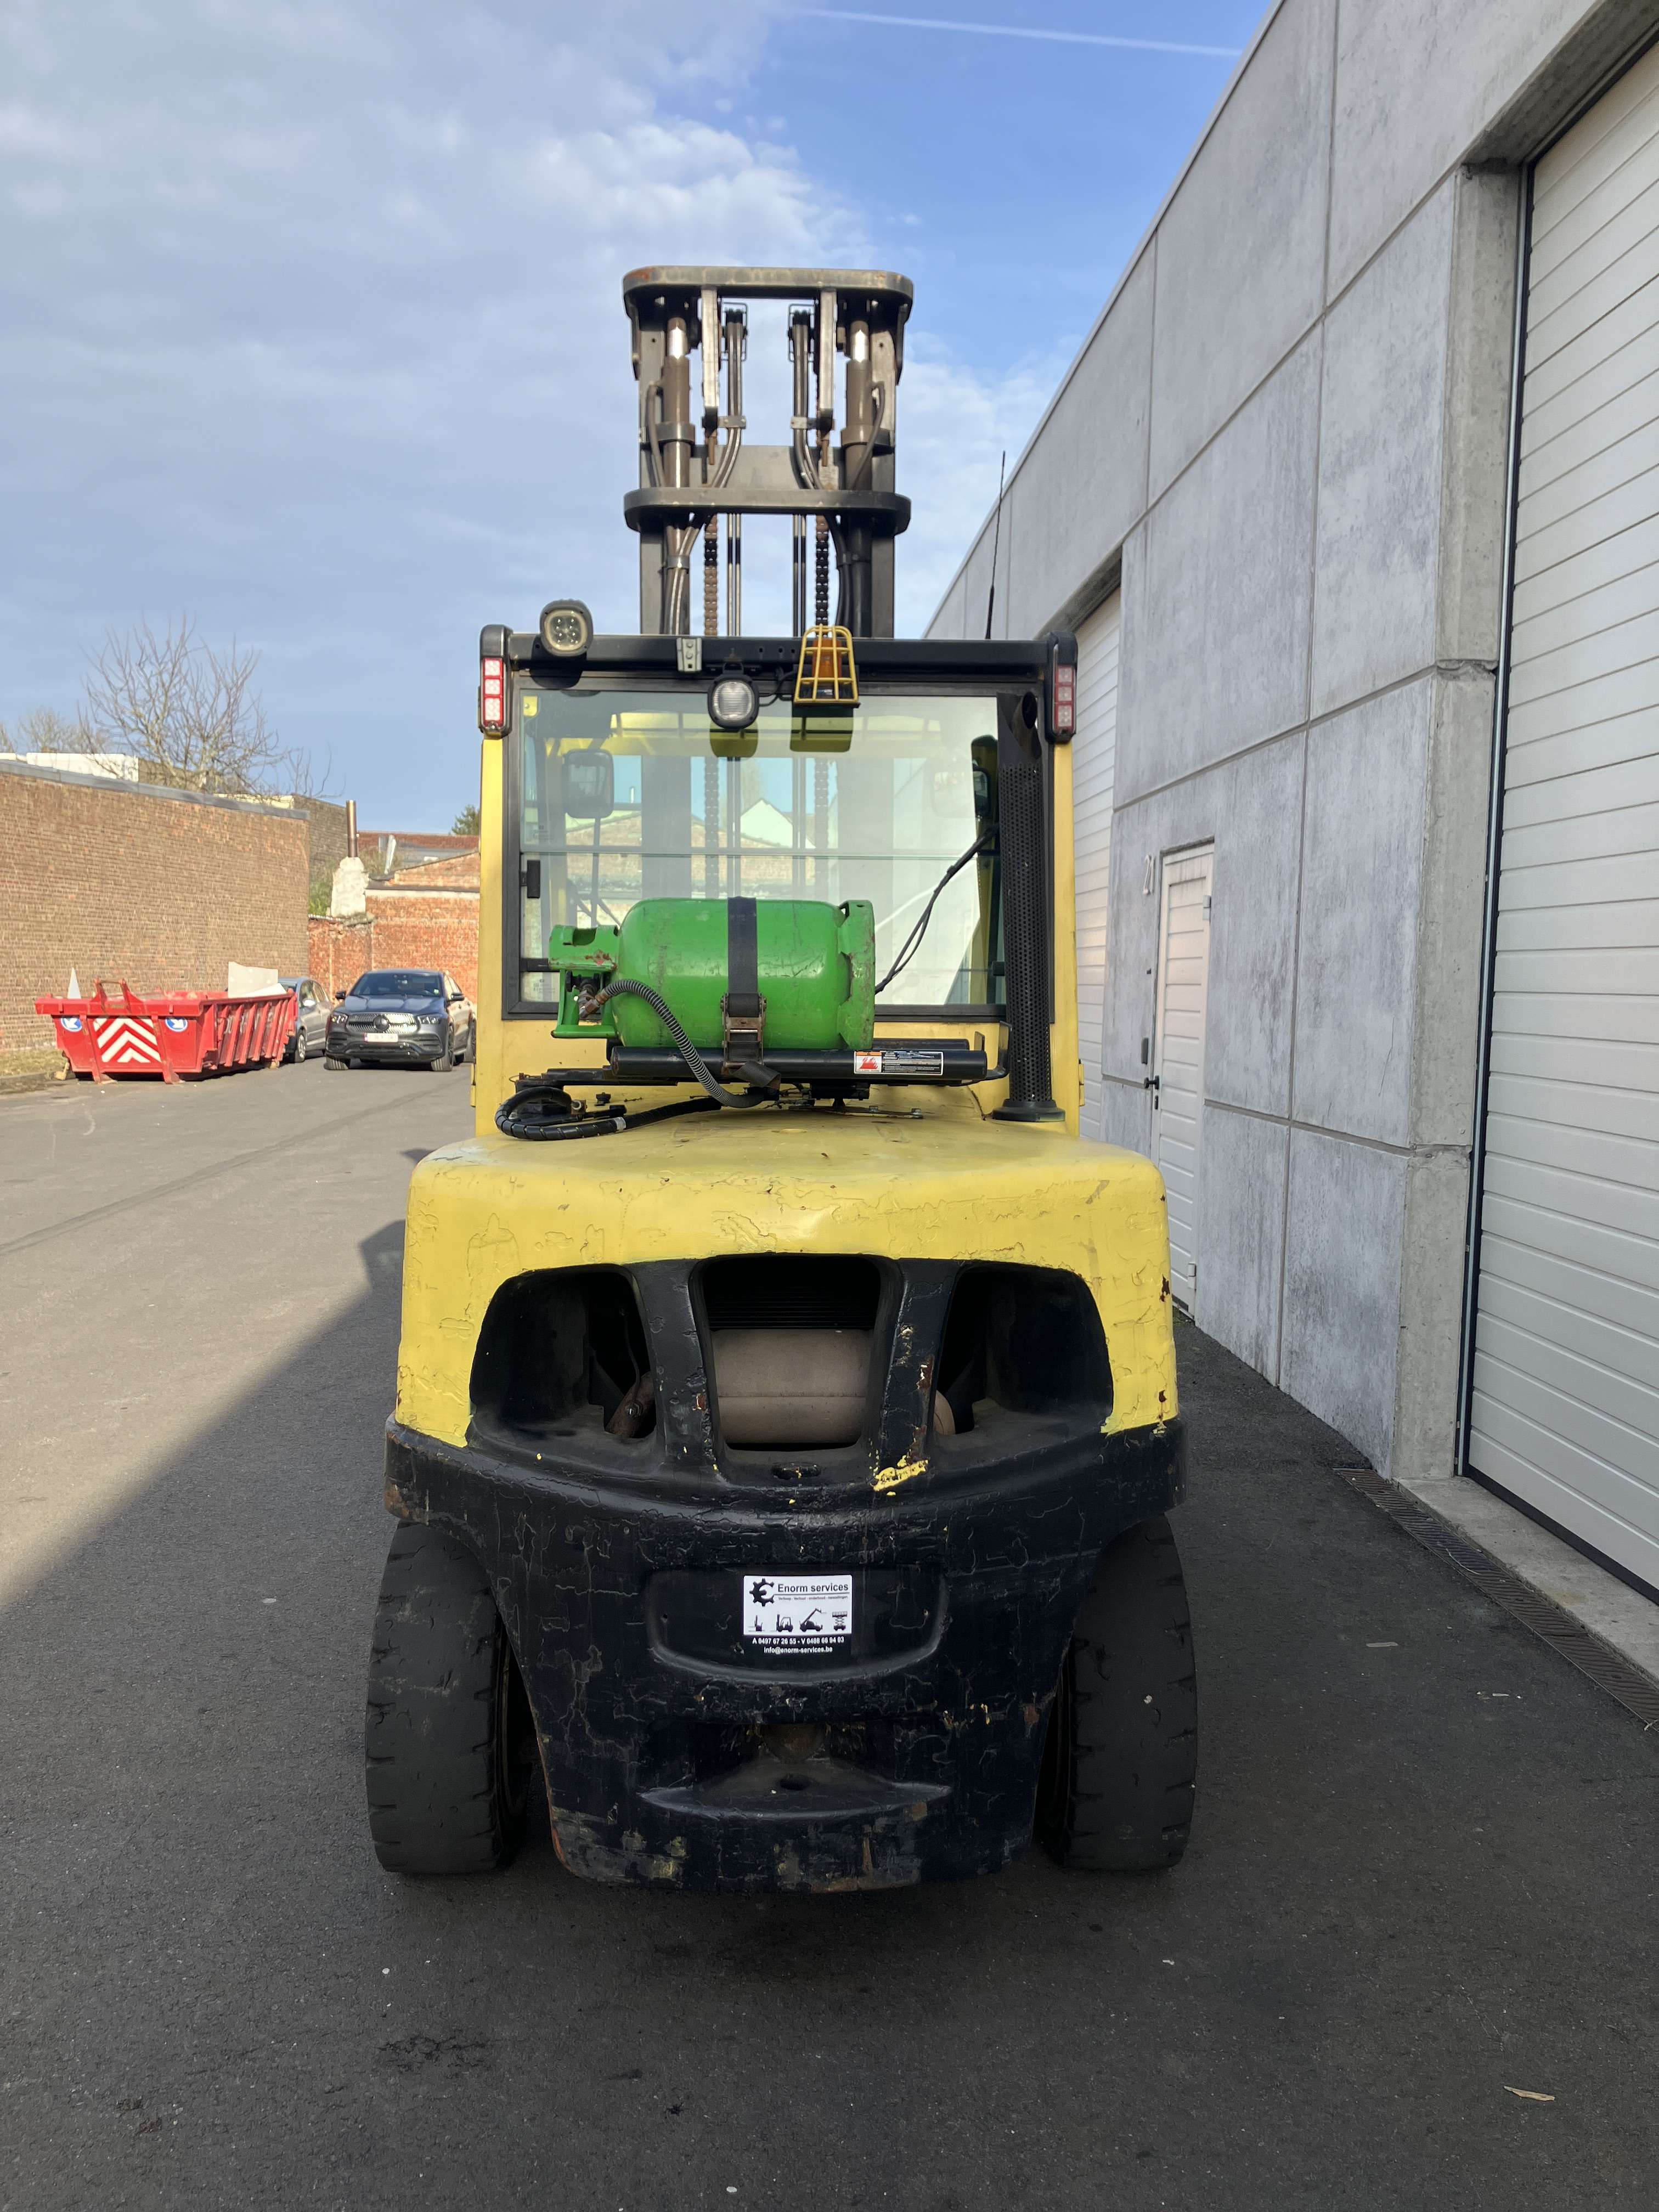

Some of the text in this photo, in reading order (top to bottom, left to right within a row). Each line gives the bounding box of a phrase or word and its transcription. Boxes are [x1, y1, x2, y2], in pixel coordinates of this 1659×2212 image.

[1143, 854, 1154, 895] 21
[778, 1582, 849, 1593] Enorm services
[764, 1646, 833, 1655] info@enorm-services.be
